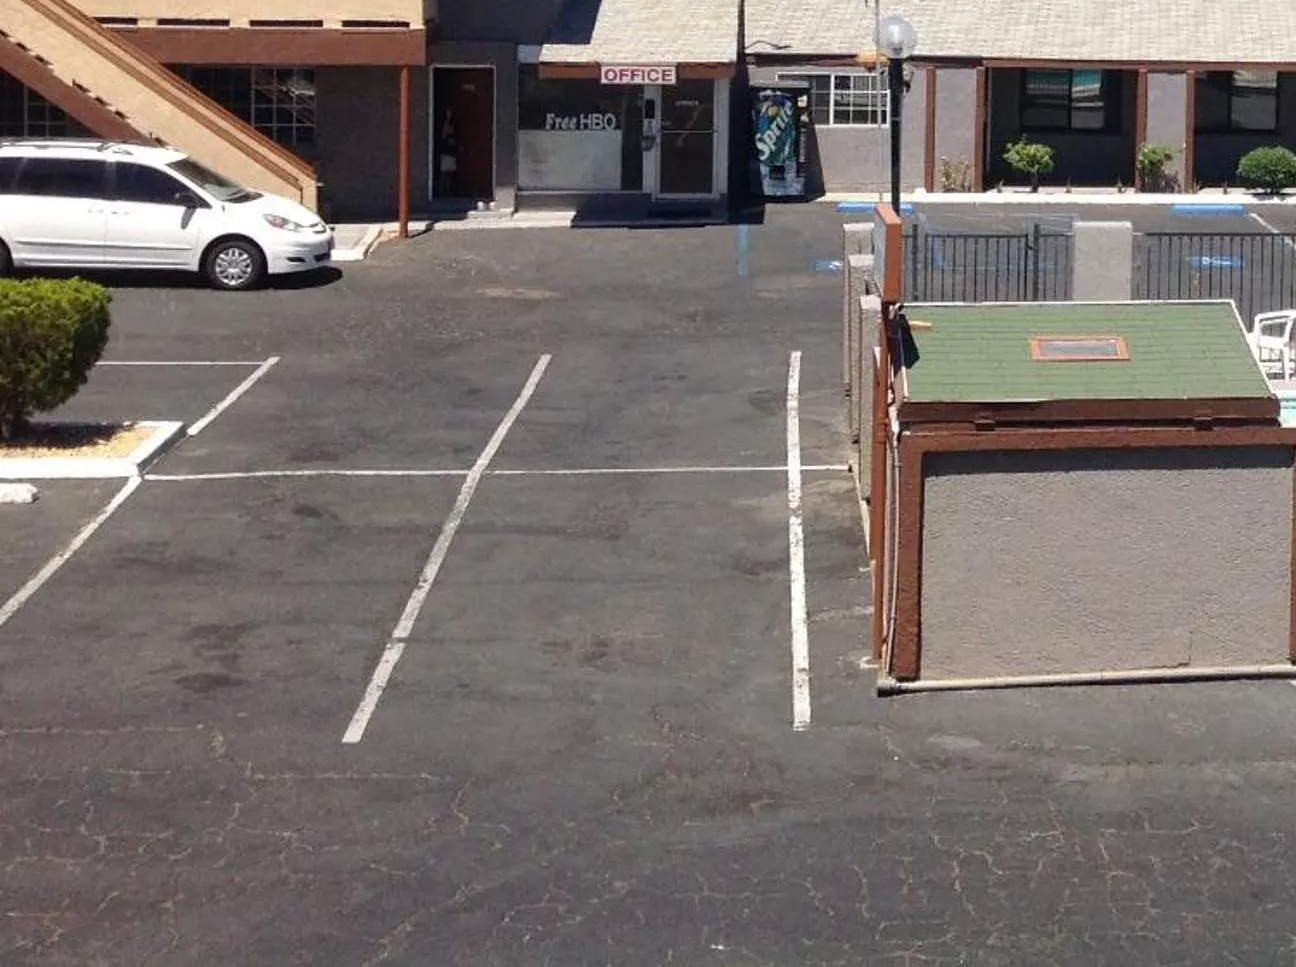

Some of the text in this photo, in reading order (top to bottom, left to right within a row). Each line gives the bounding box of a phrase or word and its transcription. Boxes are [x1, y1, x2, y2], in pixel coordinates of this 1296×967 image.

[604, 68, 673, 82] OFFICE
[545, 113, 616, 131] Free HBO
[755, 99, 793, 161] Sprite
